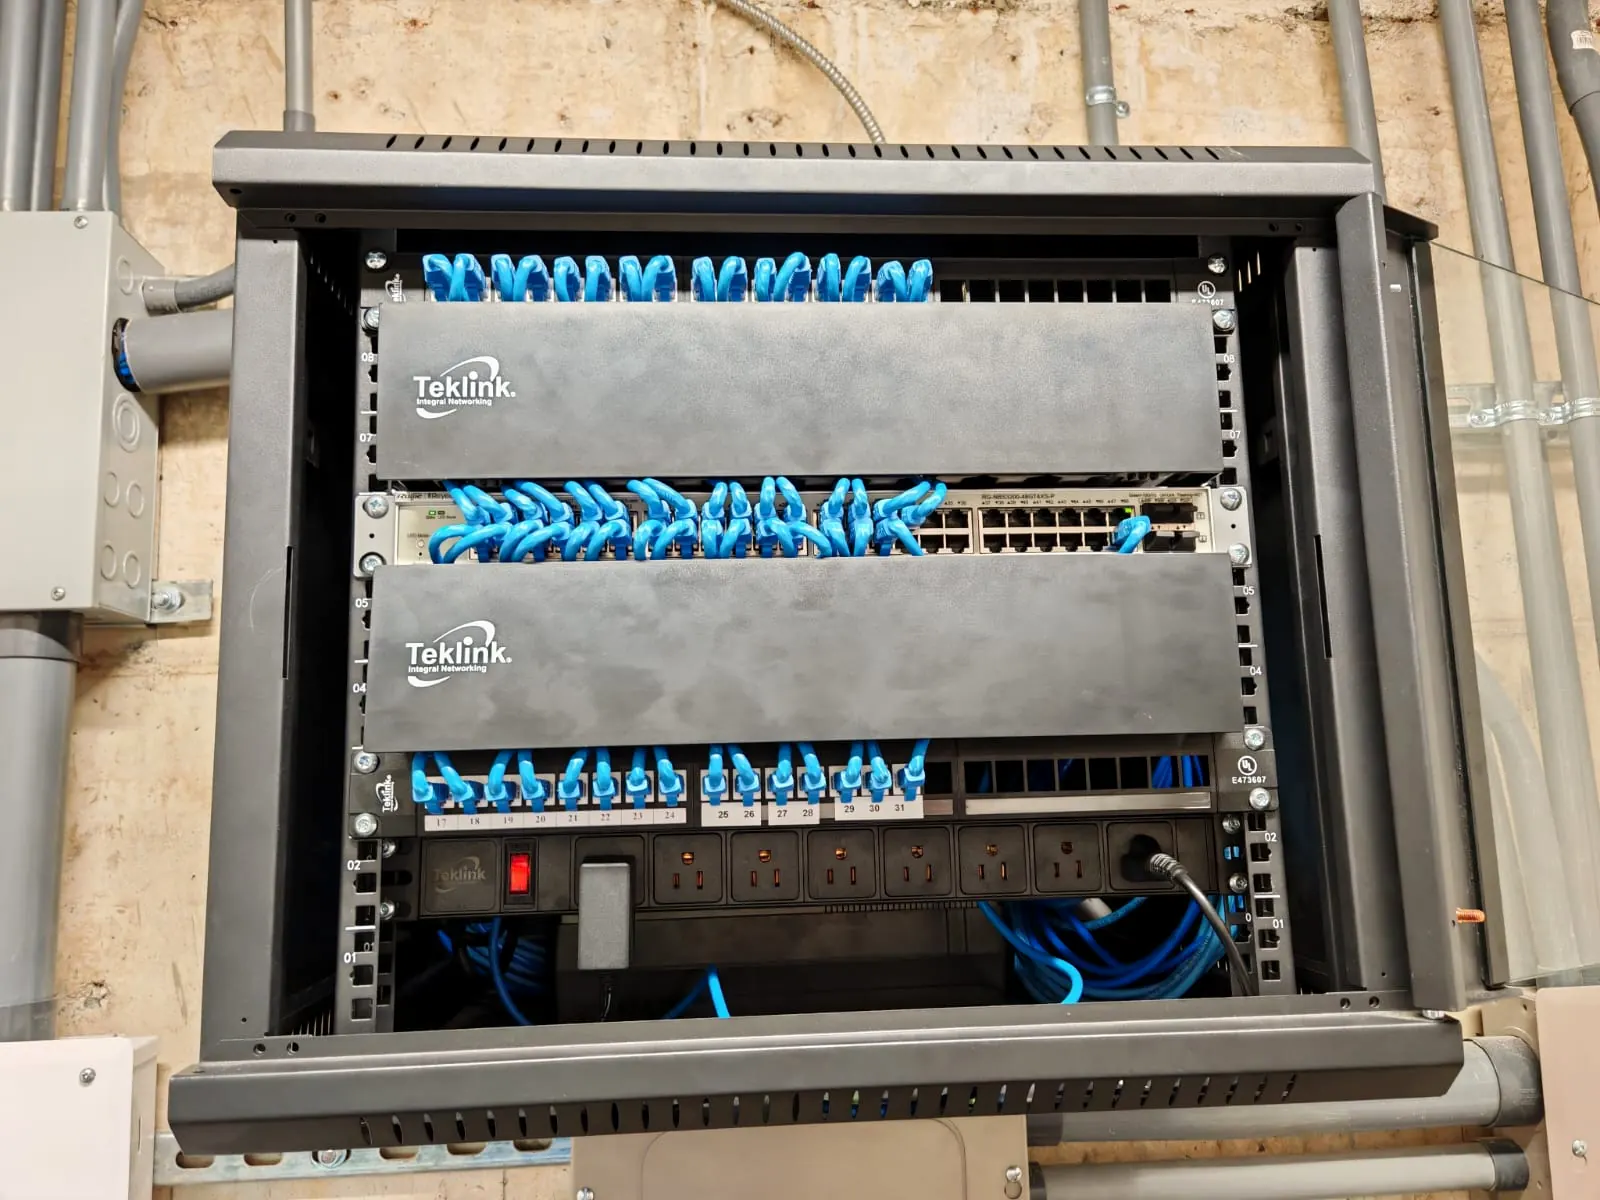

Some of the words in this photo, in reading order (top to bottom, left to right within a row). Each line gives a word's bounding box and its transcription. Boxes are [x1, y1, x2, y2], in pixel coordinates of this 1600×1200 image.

[361, 352, 374, 362] 08
[1223, 354, 1235, 363] 08
[416, 398, 446, 406] Integral
[448, 398, 492, 406] Networking
[360, 433, 373, 442] 07
[1229, 430, 1241, 439] 07
[1242, 586, 1255, 595] 05
[355, 598, 369, 608] 05
[408, 665, 439, 674] Integral
[441, 664, 487, 673] Networking
[1249, 666, 1262, 676] 04
[352, 683, 367, 693] 04
[777, 809, 788, 818] 27
[802, 808, 814, 817] 28
[844, 804, 855, 814] 29
[869, 804, 880, 813] 30
[894, 803, 905, 812] 31
[718, 810, 729, 819] 25
[744, 809, 755, 818] 26
[436, 818, 447, 828] 17
[470, 817, 480, 826] 18
[503, 815, 514, 825] 19
[535, 815, 546, 824] 20
[568, 814, 578, 823] 21
[600, 812, 611, 822] 22
[633, 811, 643, 821] 23
[665, 811, 676, 820] 24
[1264, 832, 1277, 842] 02
[347, 860, 361, 871] 02
[1272, 918, 1284, 929] 01
[344, 952, 357, 963] 01
